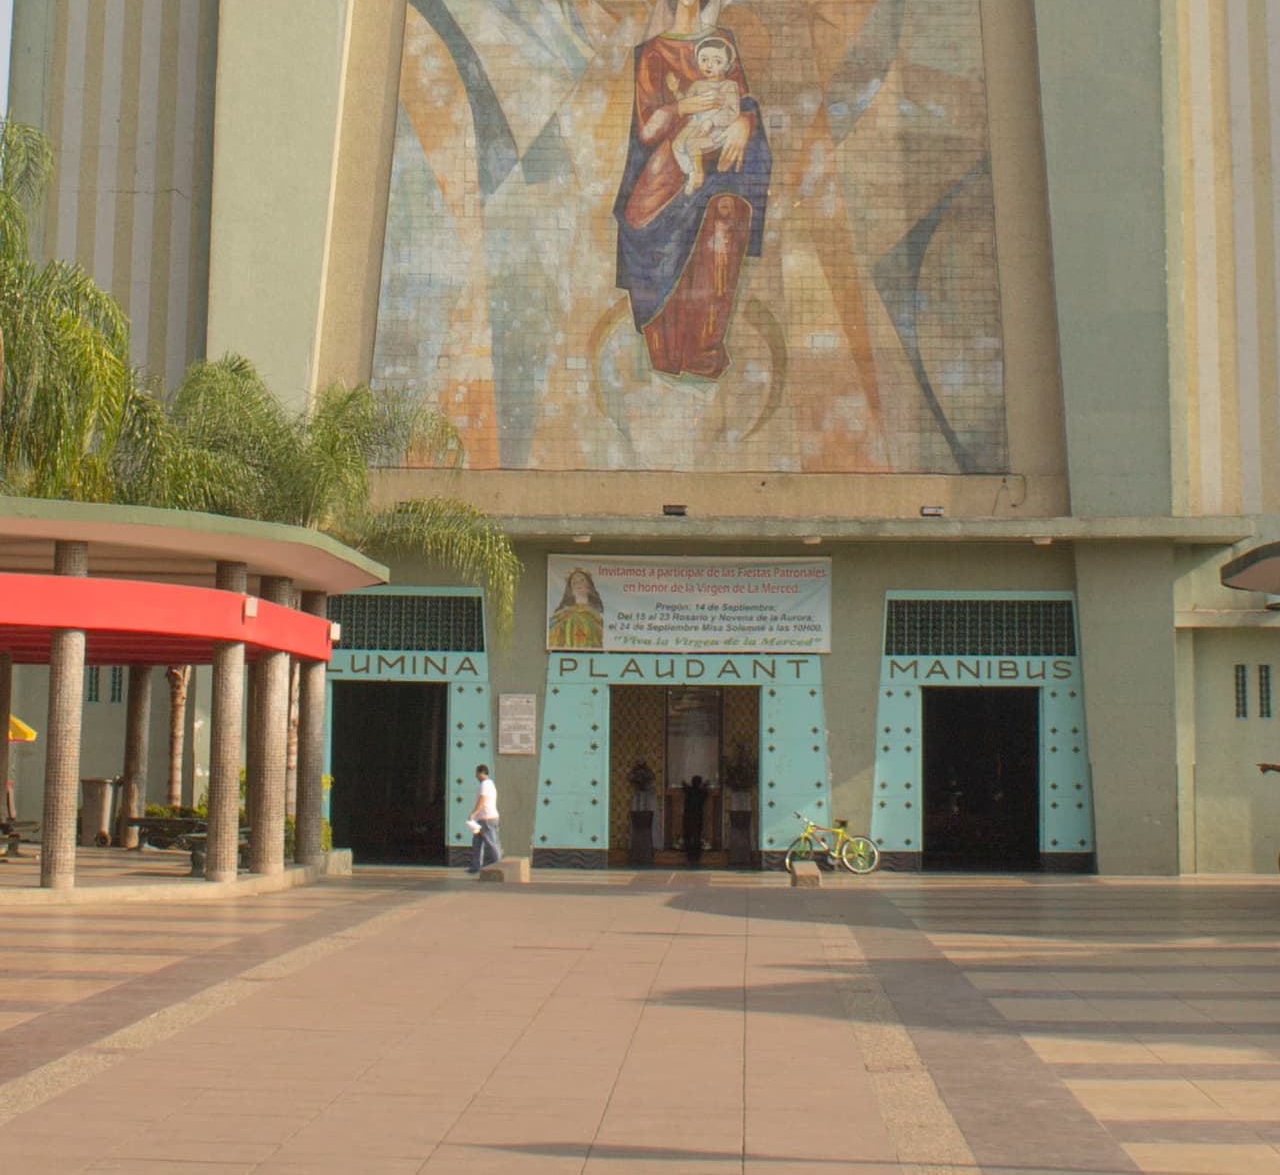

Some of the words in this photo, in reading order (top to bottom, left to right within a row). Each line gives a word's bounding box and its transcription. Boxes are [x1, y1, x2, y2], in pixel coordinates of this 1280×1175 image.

[598, 567, 646, 578] Invitamos
[648, 568, 655, 578] a
[657, 567, 704, 581] participar
[706, 567, 720, 578] de
[722, 567, 735, 578] las
[738, 567, 770, 578] Fiestas
[623, 584, 636, 592] en
[638, 582, 667, 592] honor
[671, 582, 683, 592] de
[685, 582, 694, 592] la
[696, 582, 730, 596] Virgen
[732, 582, 745, 593] de
[748, 582, 759, 593] La
[707, 602, 720, 611] de
[617, 612, 632, 620] Del
[648, 612, 658, 620] al
[672, 612, 708, 621] Rosario
[719, 613, 753, 622] Novena
[756, 613, 768, 622] de
[770, 613, 778, 622] la
[633, 623, 644, 631] de
[646, 623, 700, 632] Septiembre
[702, 624, 724, 632] Misa
[726, 624, 767, 632] Solemne
[776, 624, 790, 632] las
[656, 636, 668, 645] la
[674, 636, 720, 648] Virgen
[723, 637, 739, 646] de
[742, 636, 757, 646] la
[325, 654, 478, 676] LUMINA
[559, 658, 809, 678] PLAUDANT
[890, 659, 1072, 680] MANIBUS
